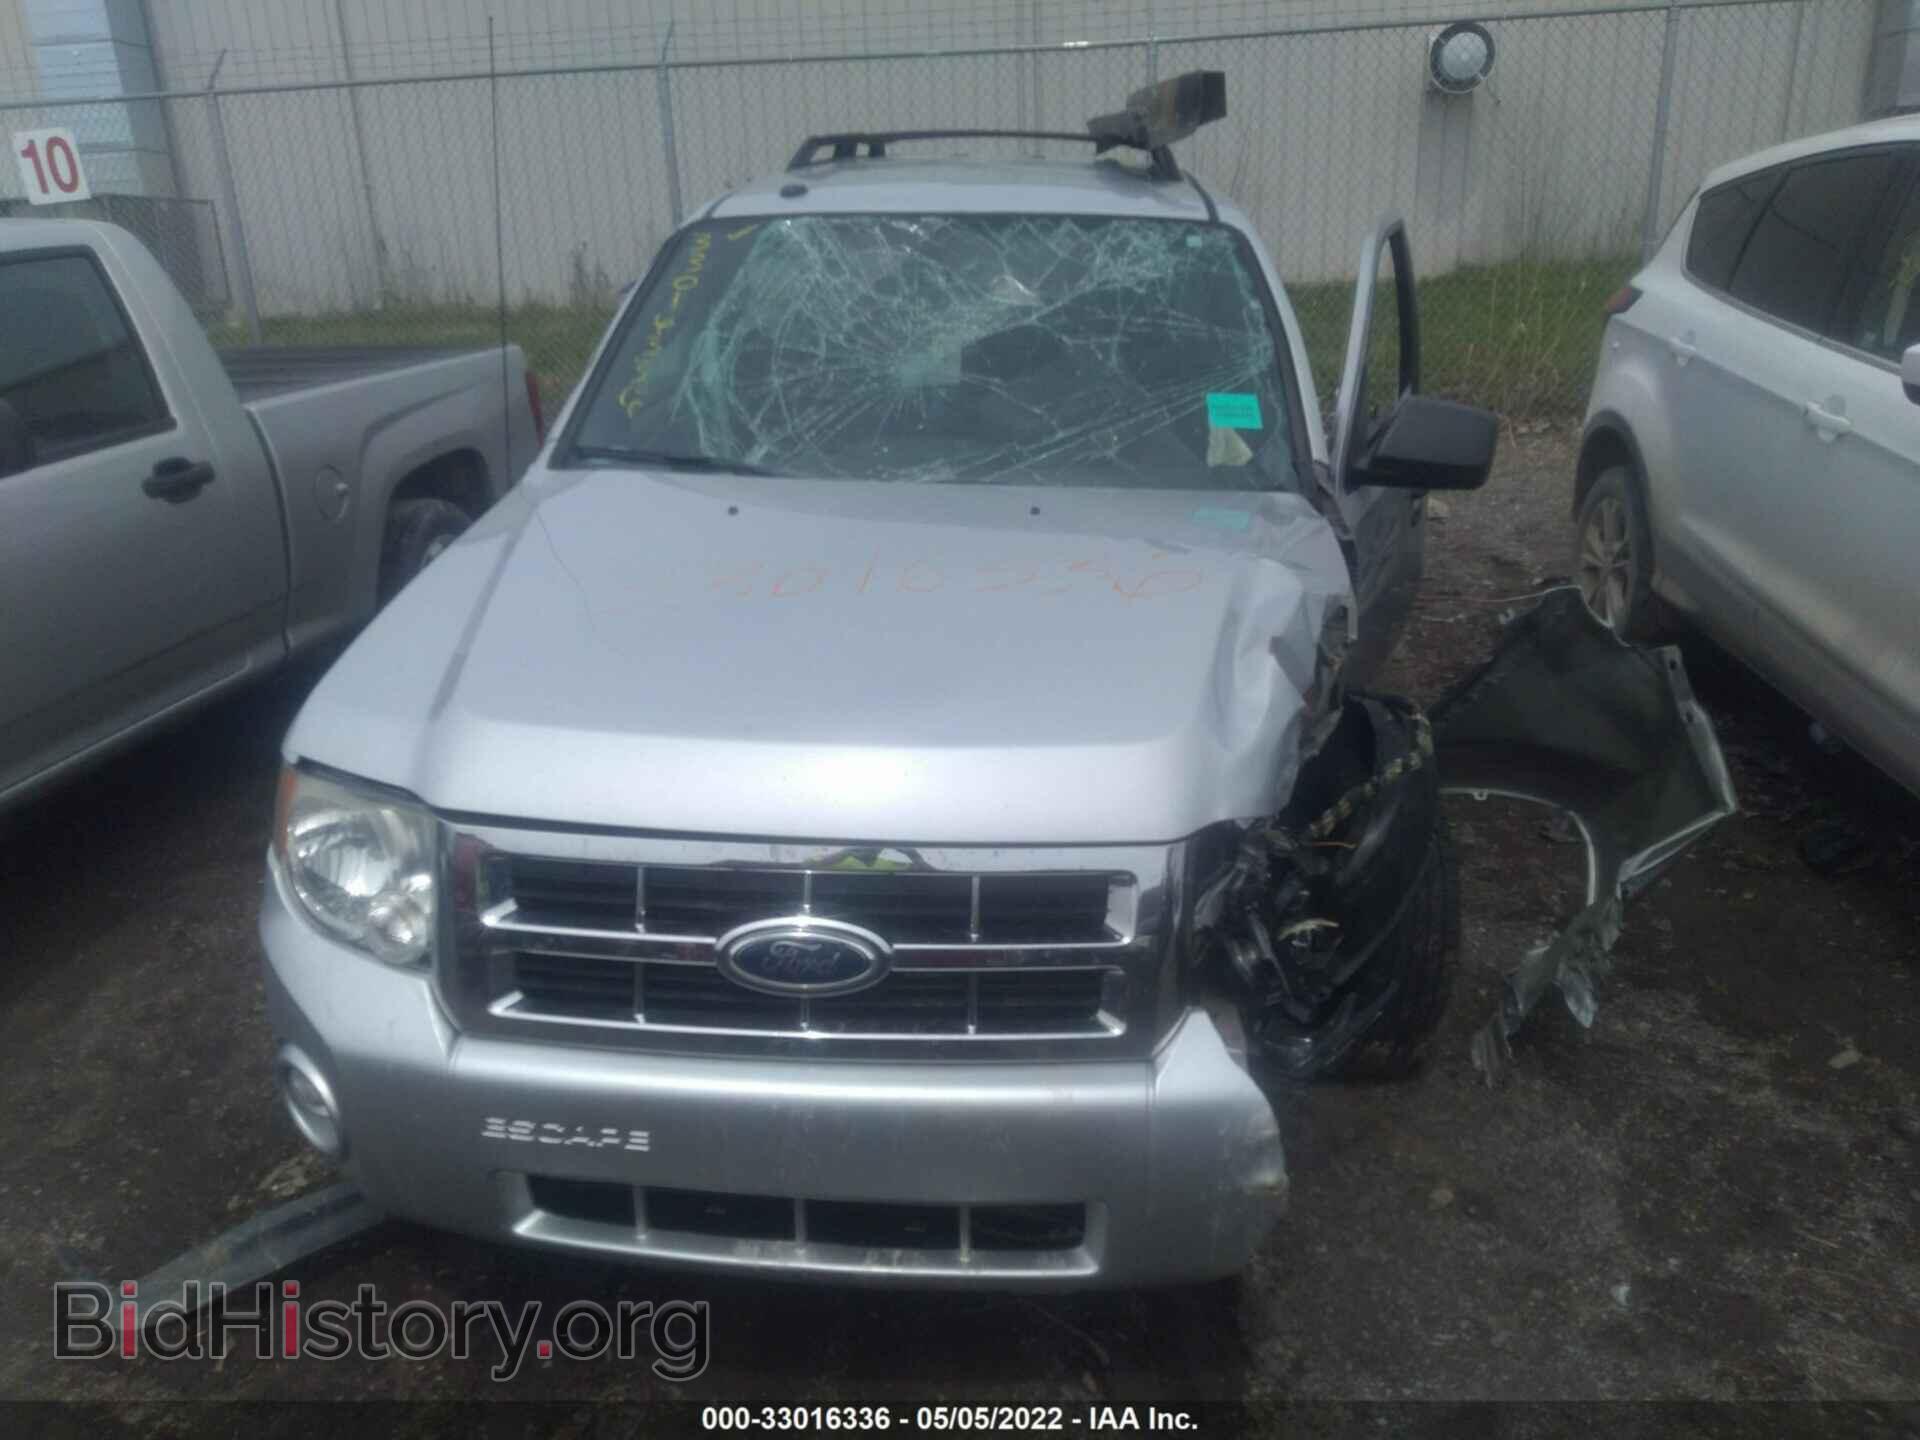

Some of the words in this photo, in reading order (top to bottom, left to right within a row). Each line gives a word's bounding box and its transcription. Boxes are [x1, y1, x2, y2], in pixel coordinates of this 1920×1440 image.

[20, 136, 80, 194] 10
[760, 940, 841, 975] Ford
[481, 1116, 651, 1152] ESCAPE
